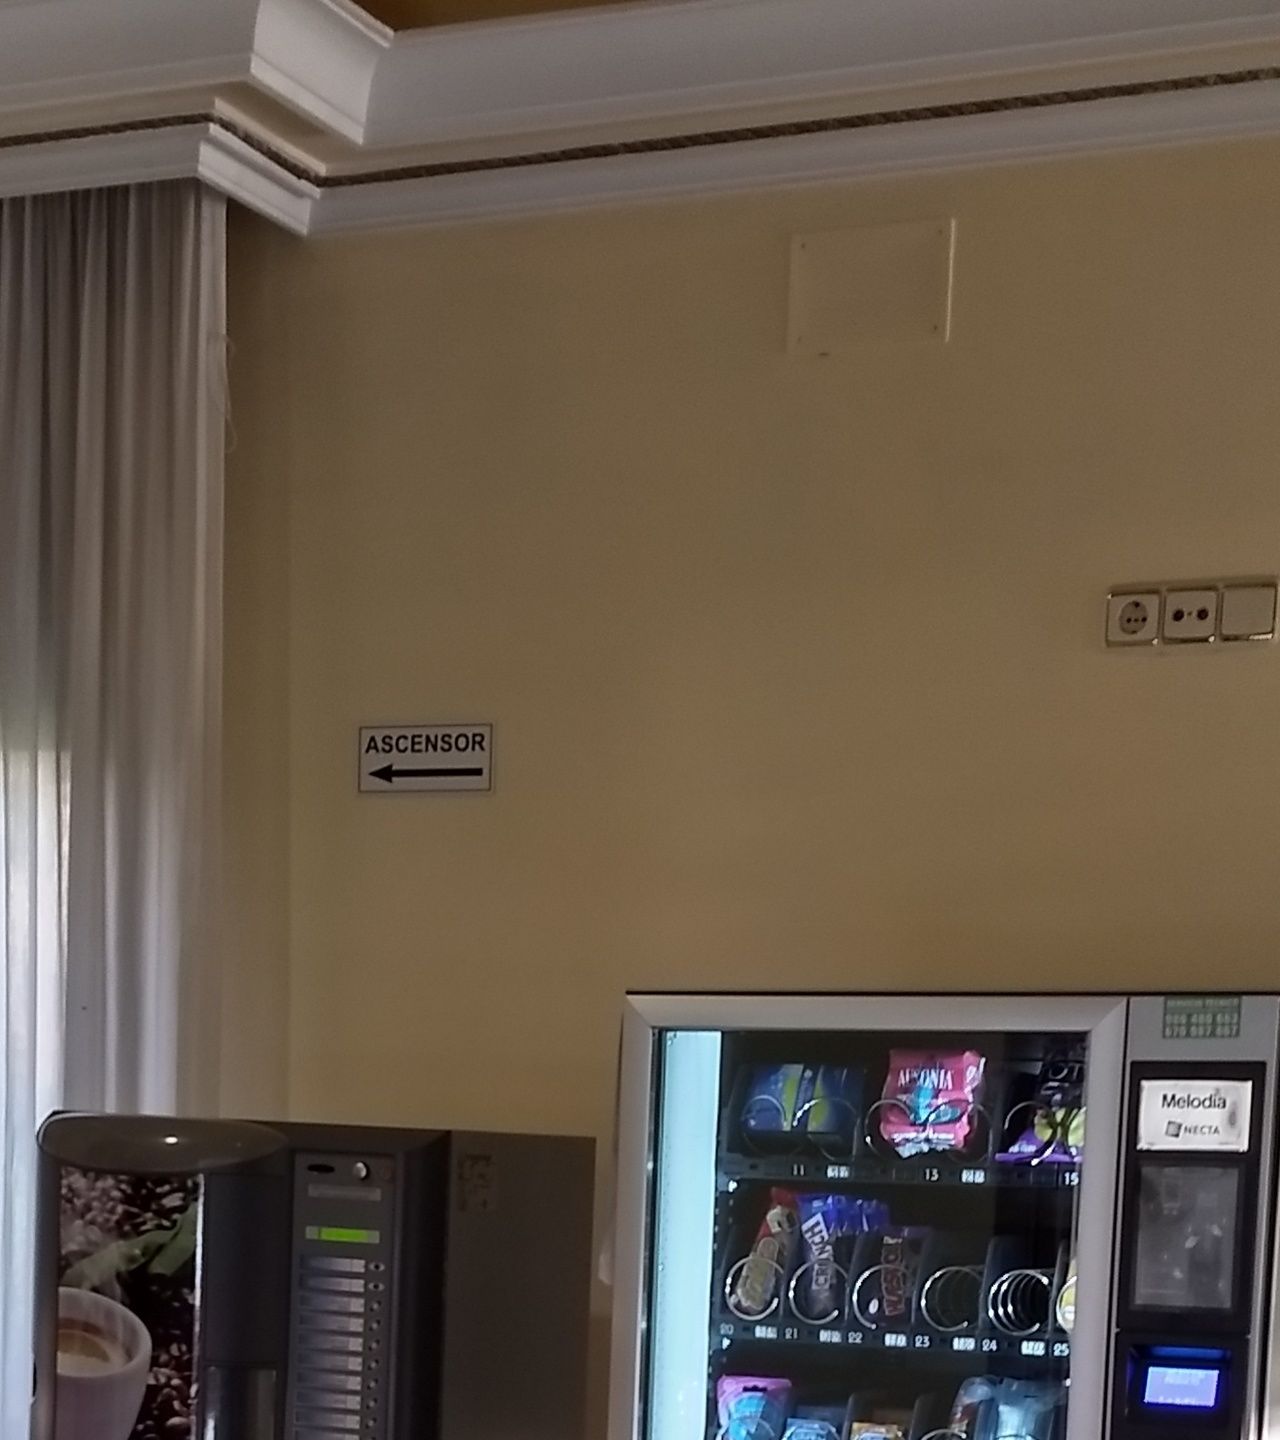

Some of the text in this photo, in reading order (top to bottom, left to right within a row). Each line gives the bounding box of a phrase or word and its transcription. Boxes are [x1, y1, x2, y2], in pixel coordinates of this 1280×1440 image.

[365, 733, 486, 754] ASCENSOR
[897, 1067, 954, 1091] AUSONIA
[1184, 1125, 1221, 1135] NECTA
[792, 1164, 1079, 1187] 11 13 15
[915, 1335, 930, 1348] 23
[982, 1339, 997, 1352] 24
[1053, 1343, 1070, 1356] 25
